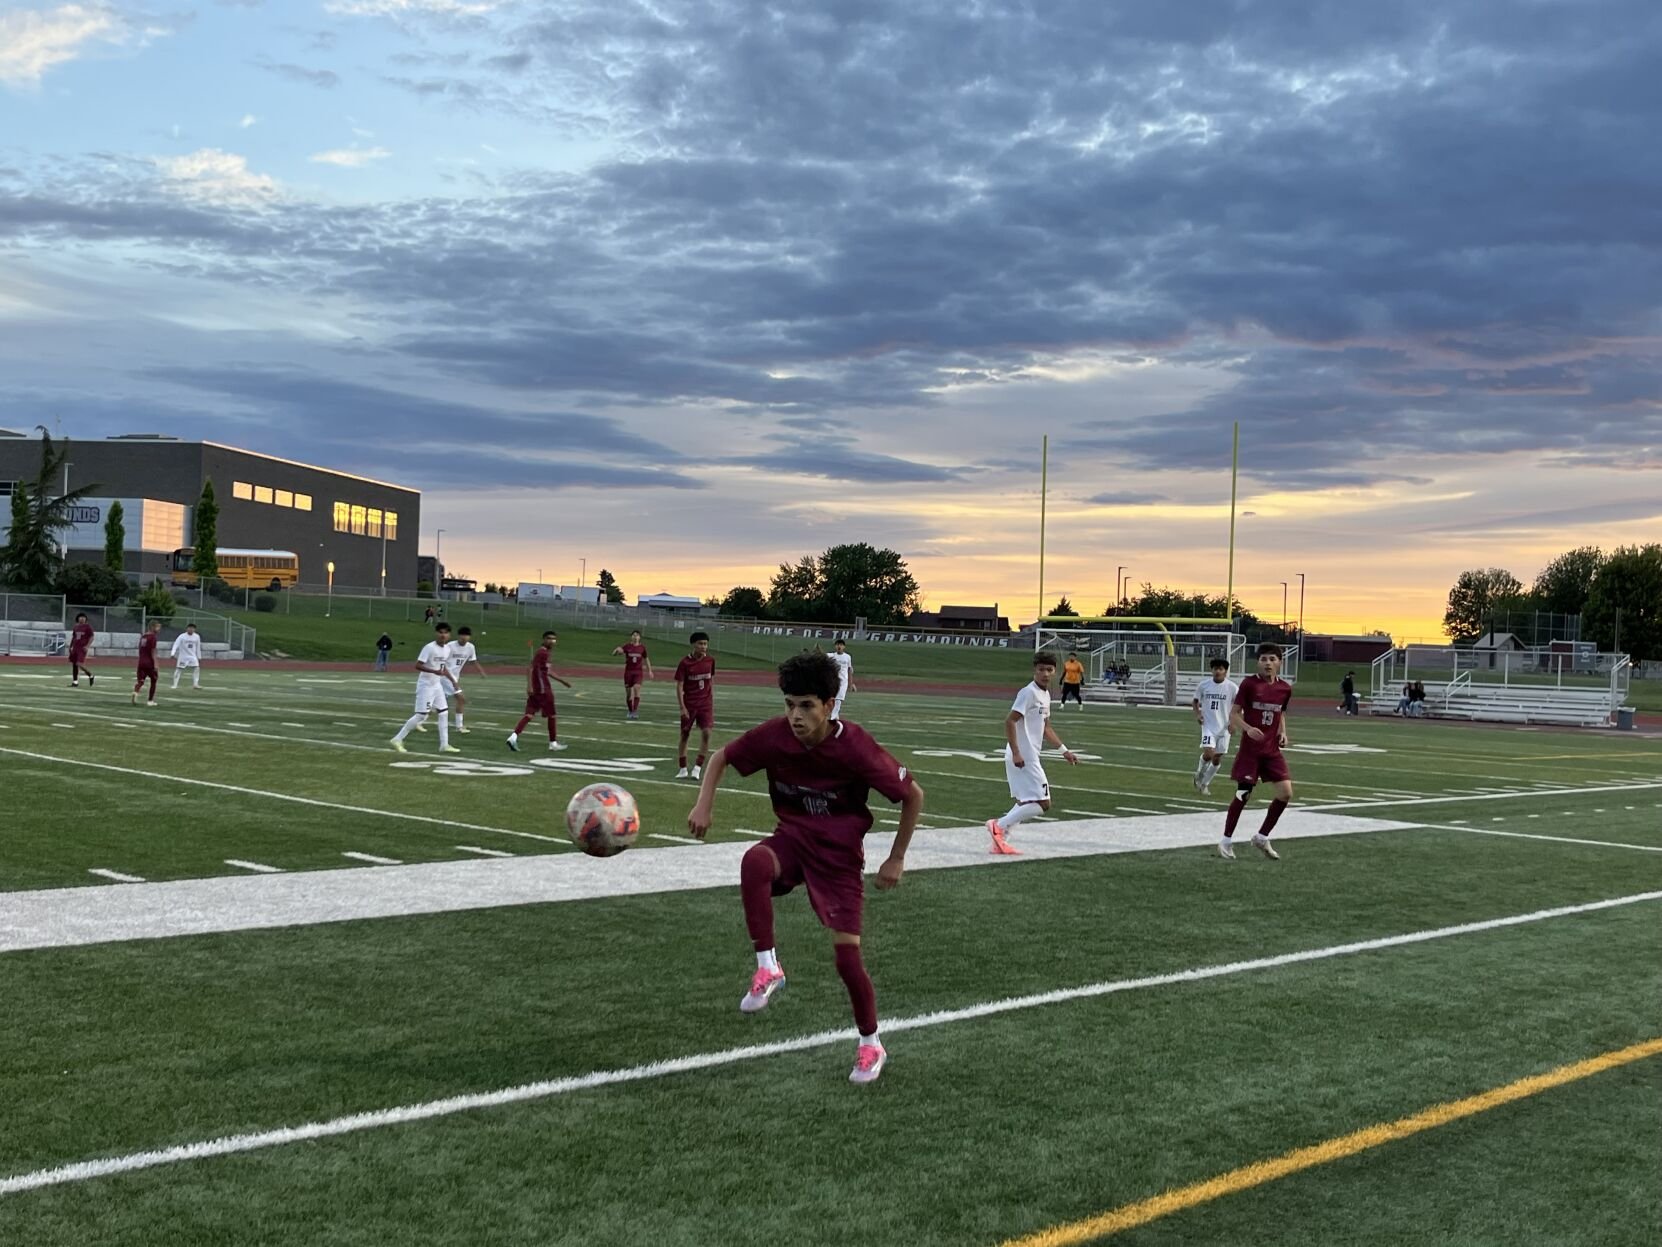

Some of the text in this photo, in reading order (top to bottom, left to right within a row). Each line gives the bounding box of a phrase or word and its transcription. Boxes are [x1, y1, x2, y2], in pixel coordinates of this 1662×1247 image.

[753, 626, 794, 637] HOME
[803, 629, 823, 638] OF
[870, 632, 1009, 648] GREYHOUNDS
[426, 702, 431, 710] 5
[1210, 700, 1219, 710] 21
[1261, 711, 1274, 726] 13
[1202, 735, 1211, 745] 21
[1042, 783, 1049, 797] 7
